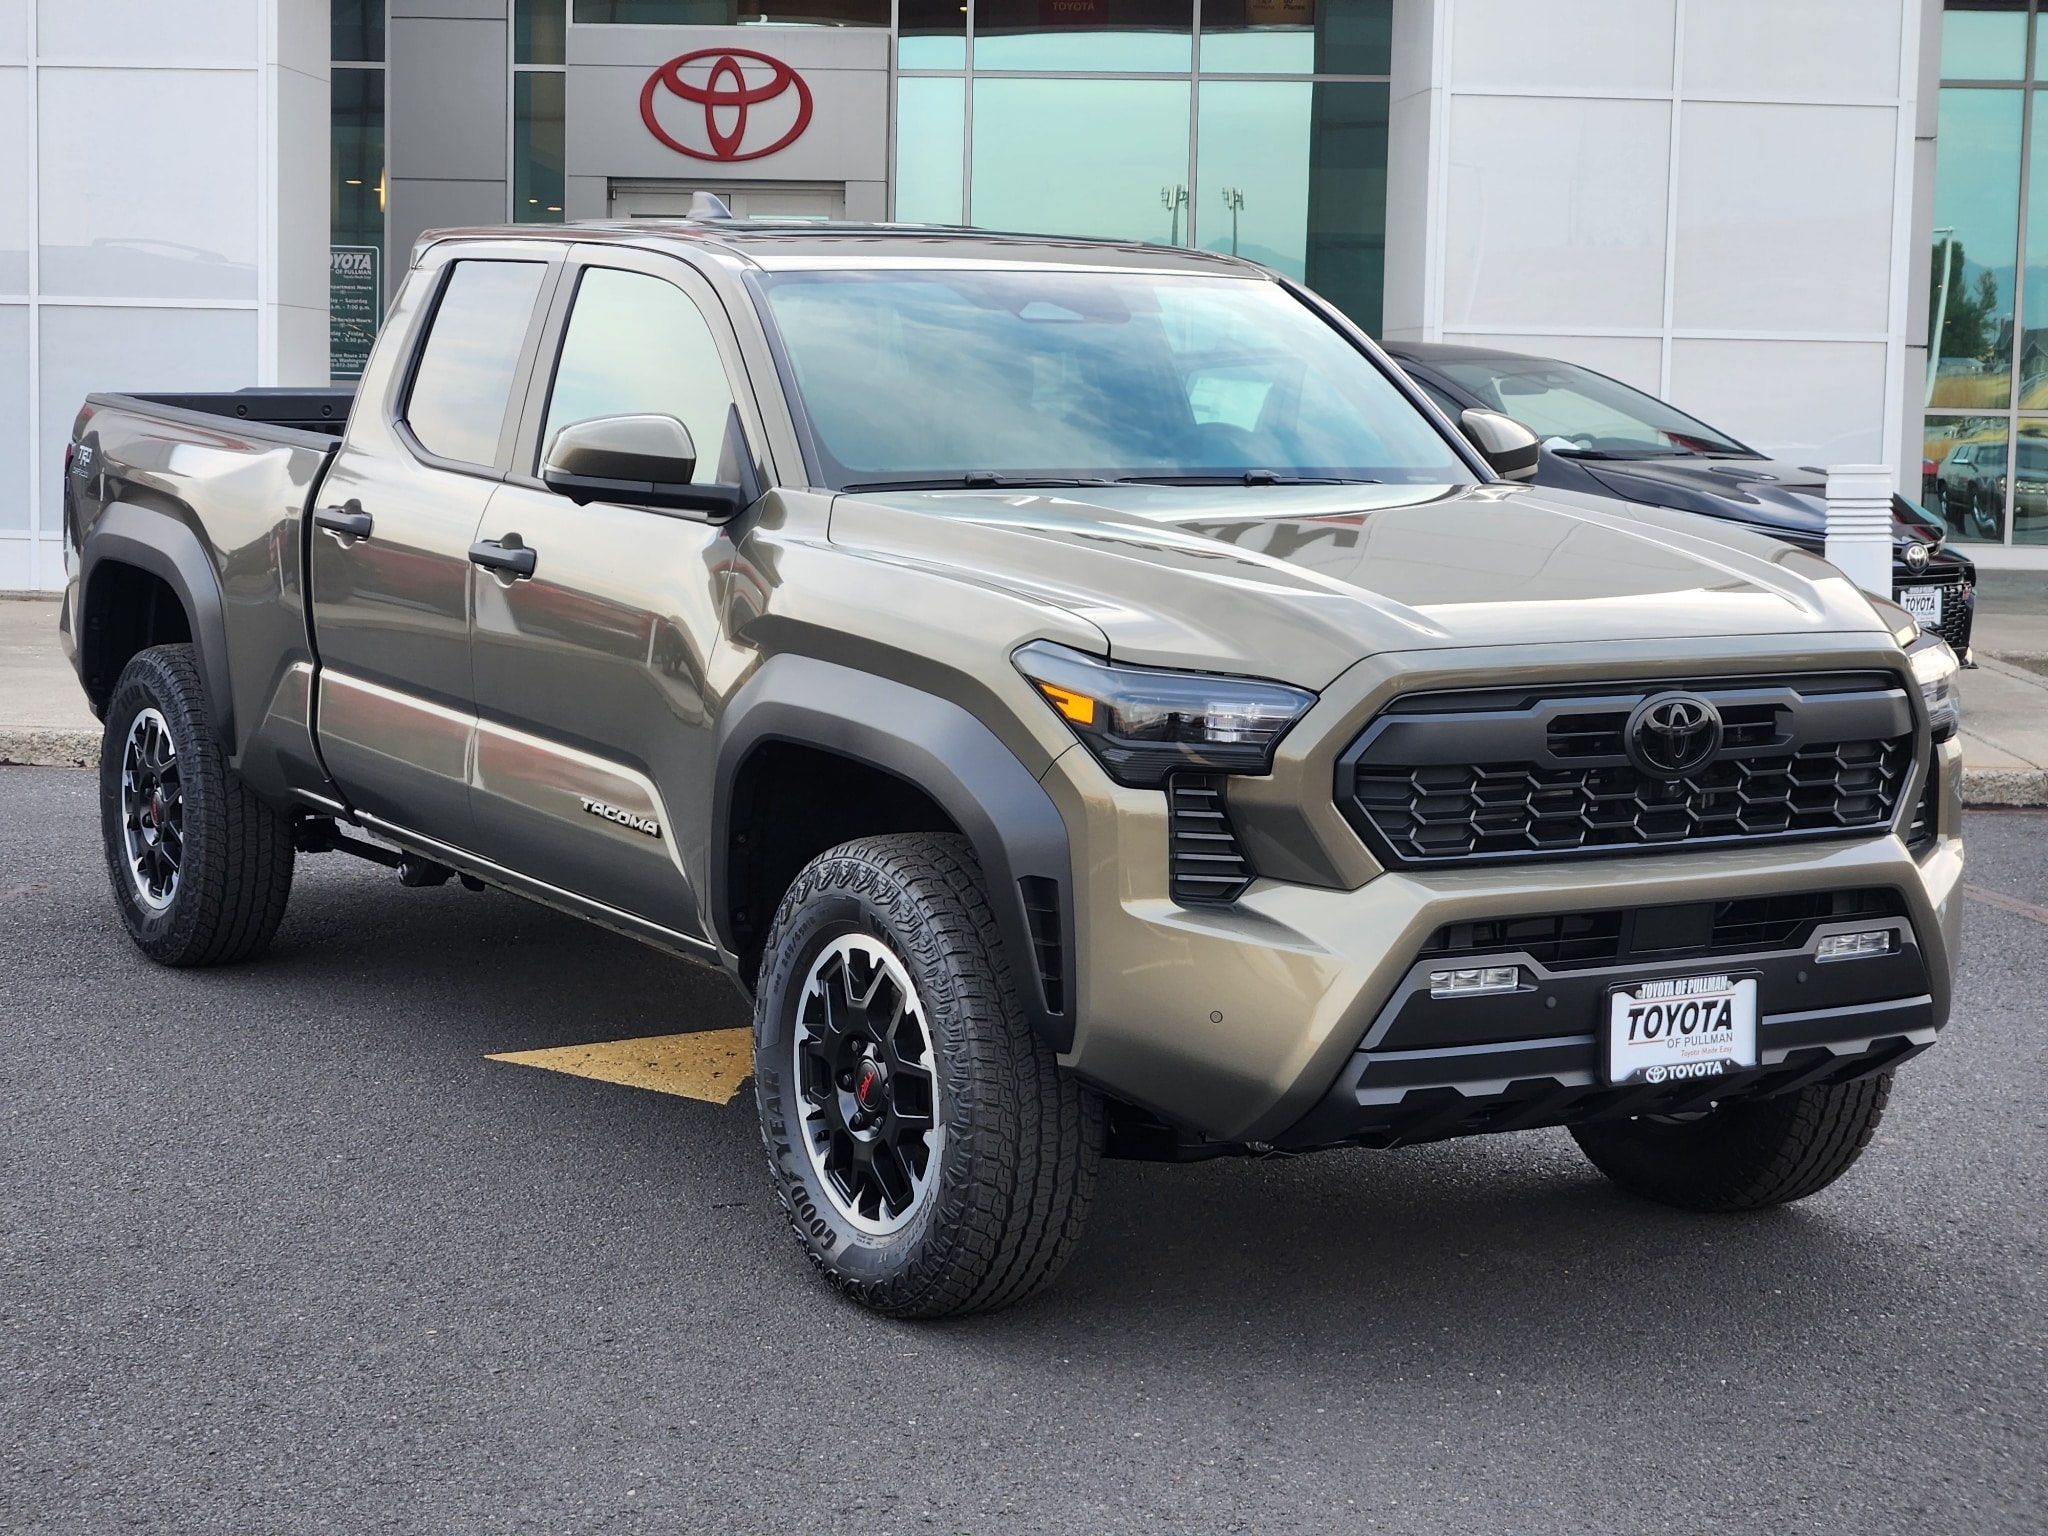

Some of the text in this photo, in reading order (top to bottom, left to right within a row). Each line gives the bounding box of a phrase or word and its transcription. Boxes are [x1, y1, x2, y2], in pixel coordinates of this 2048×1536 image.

[1052, 1, 1095, 12] TOYOTA
[78, 445, 93, 467] TRD
[1905, 597, 1935, 611] TOYOTA
[580, 796, 660, 837] TACOMA
[1641, 975, 1728, 999] TOYOTA OF PULLMAN
[1627, 998, 1732, 1041] TOYOTA
[1667, 1032, 1733, 1049] OF PULLMAN
[1681, 1046, 1733, 1058] Toyota Made Easy
[1667, 1061, 1723, 1080] TOYOTA
